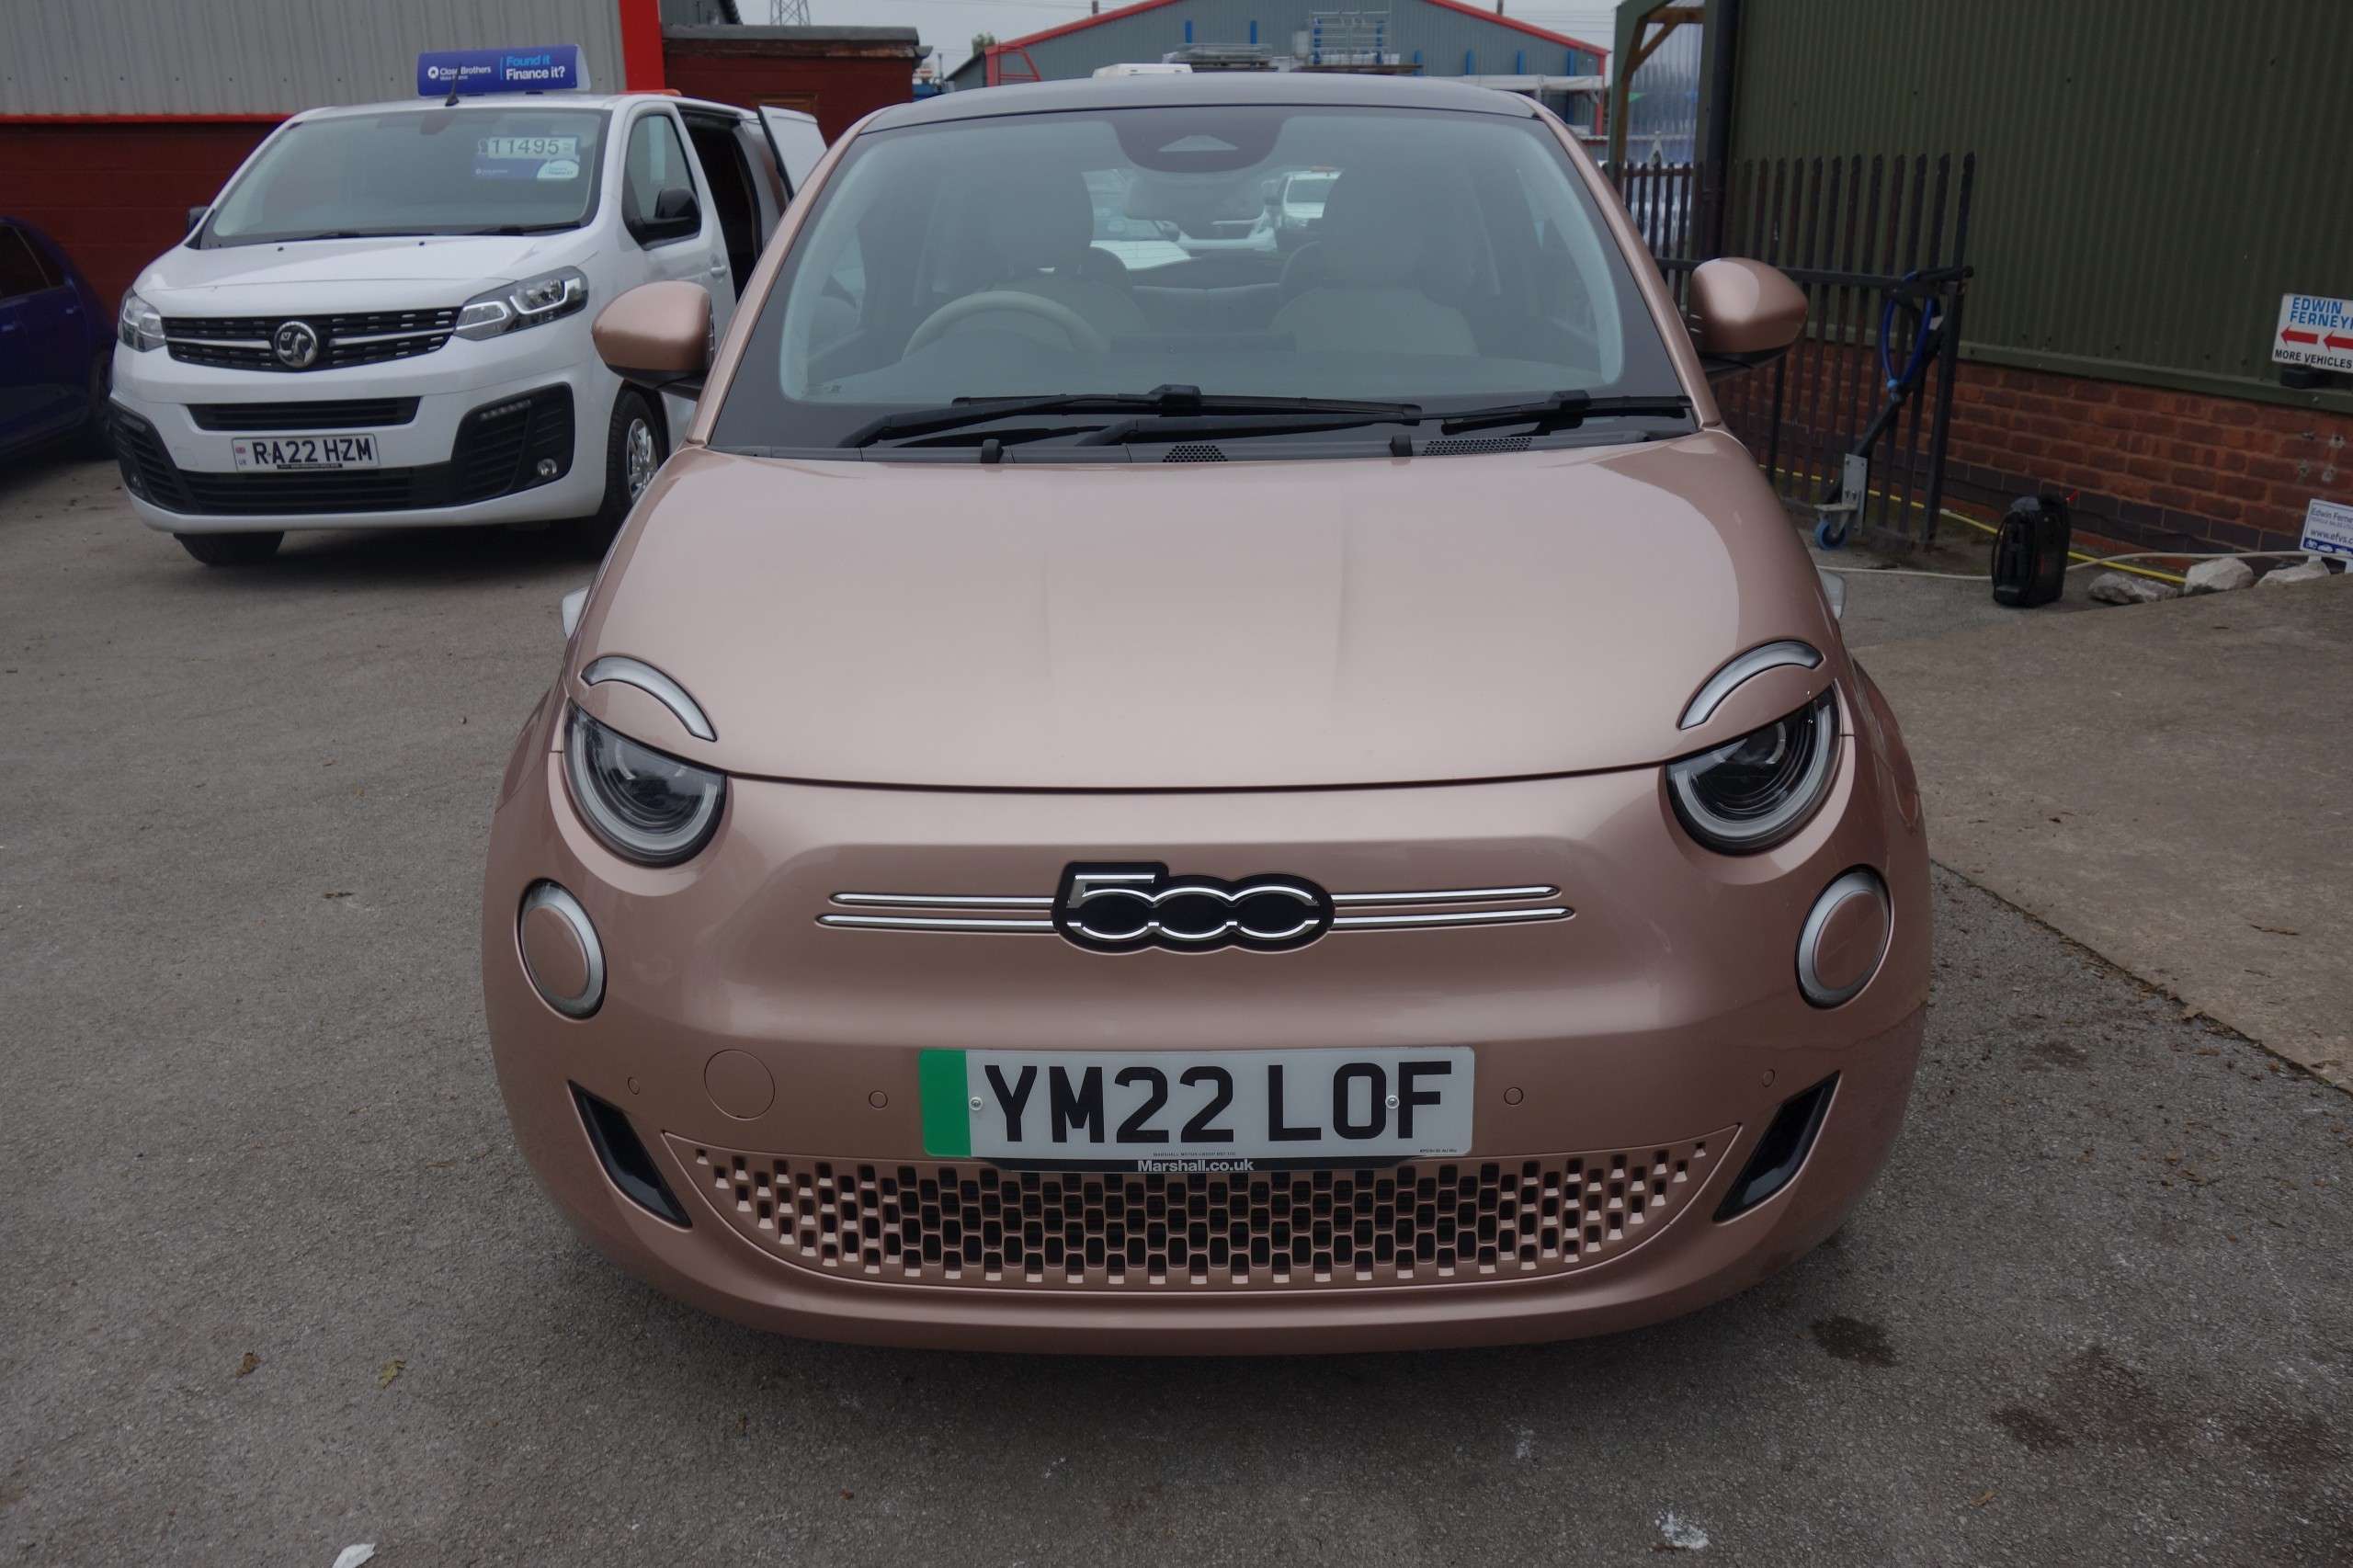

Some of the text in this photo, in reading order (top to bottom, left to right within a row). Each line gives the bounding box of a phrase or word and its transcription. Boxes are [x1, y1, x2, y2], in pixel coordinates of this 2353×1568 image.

[506, 54, 551, 66] Found it
[440, 66, 492, 75] Clos Brothers
[506, 66, 565, 80] Finance it?
[2292, 297, 2343, 314] EDWIN
[2274, 349, 2353, 369] MORE VEHICLES
[252, 437, 372, 465] RA22 HZM
[1066, 874, 1321, 941] 500
[984, 1061, 1452, 1143] YM22 LOF
[1137, 1158, 1255, 1172] Marshall.co.uk
